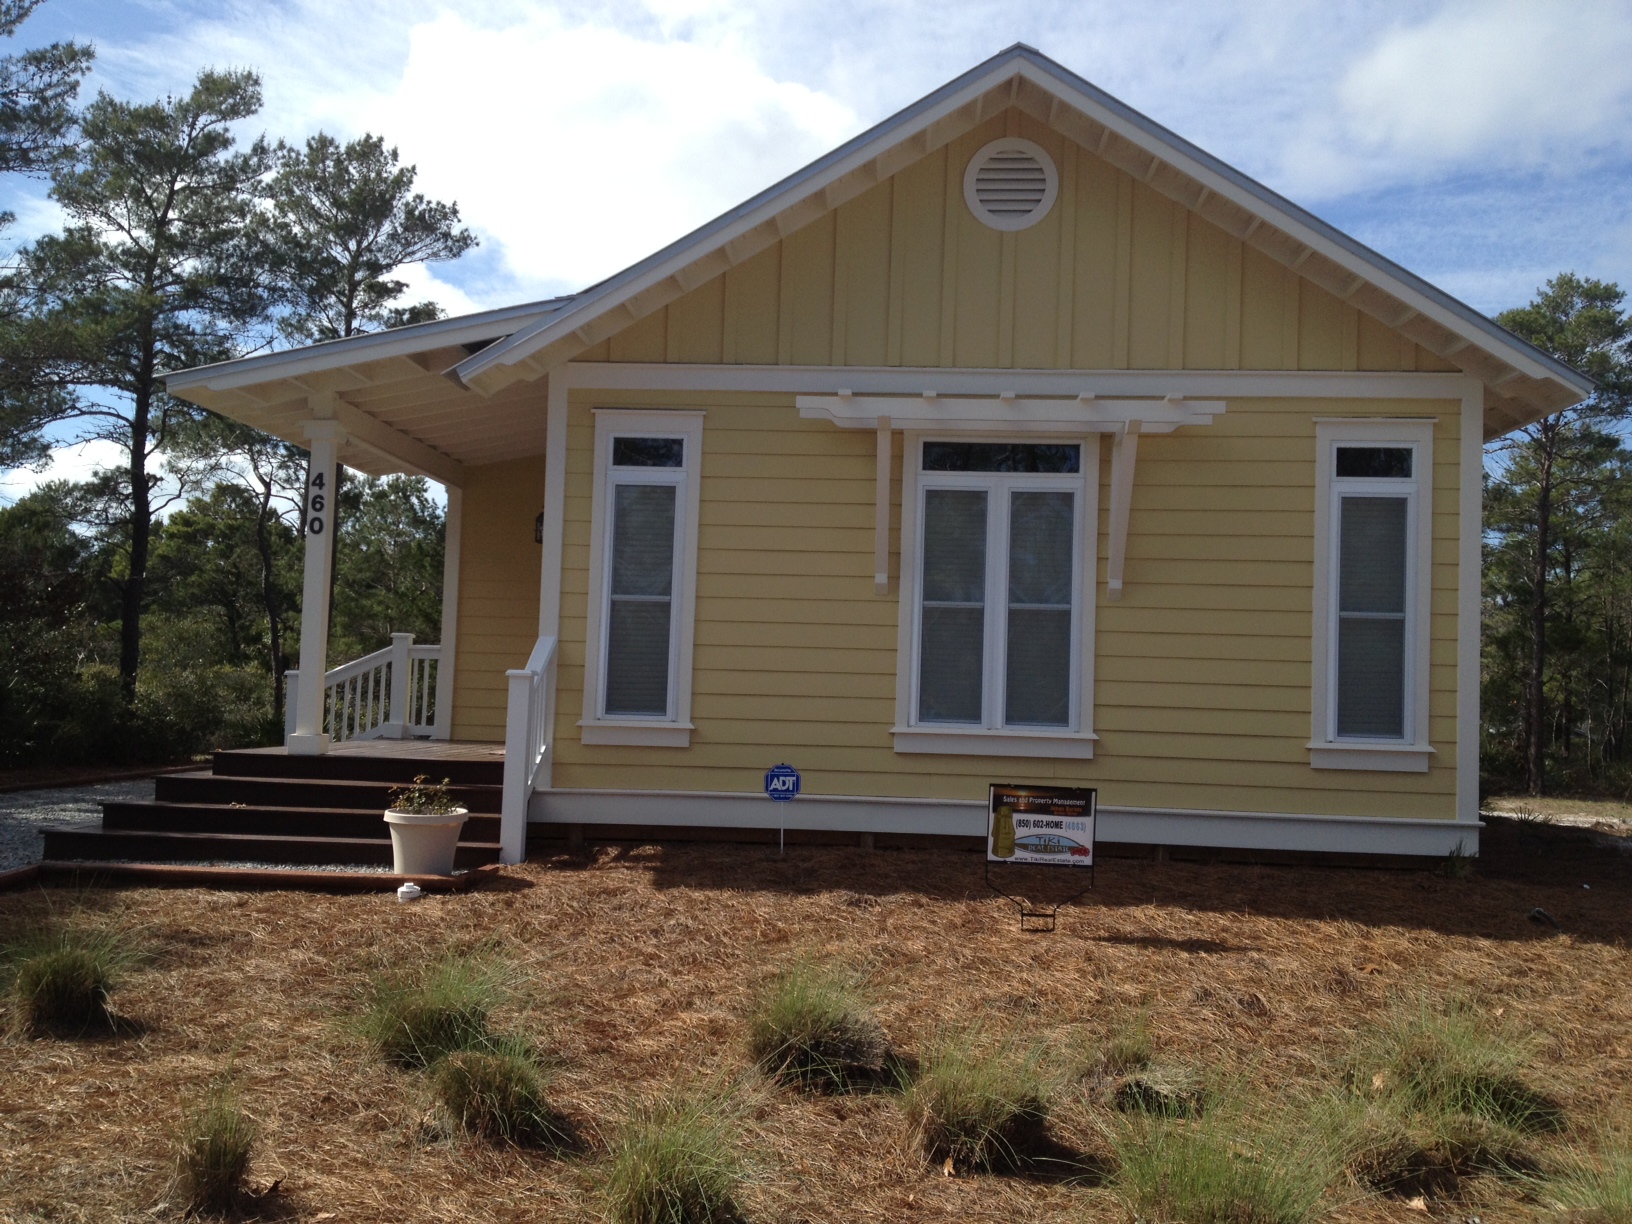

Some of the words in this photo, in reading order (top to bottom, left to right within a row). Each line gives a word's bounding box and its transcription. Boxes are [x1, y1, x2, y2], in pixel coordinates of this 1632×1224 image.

[309, 472, 326, 535] 460
[769, 776, 796, 791] ADT
[1029, 797, 1052, 805] Property
[1053, 798, 1086, 806] Management
[1015, 818, 1031, 829] (850)
[1033, 820, 1063, 829] 602-HOME
[1028, 844, 1046, 852] REAL
[1046, 845, 1070, 853] ESTATE
